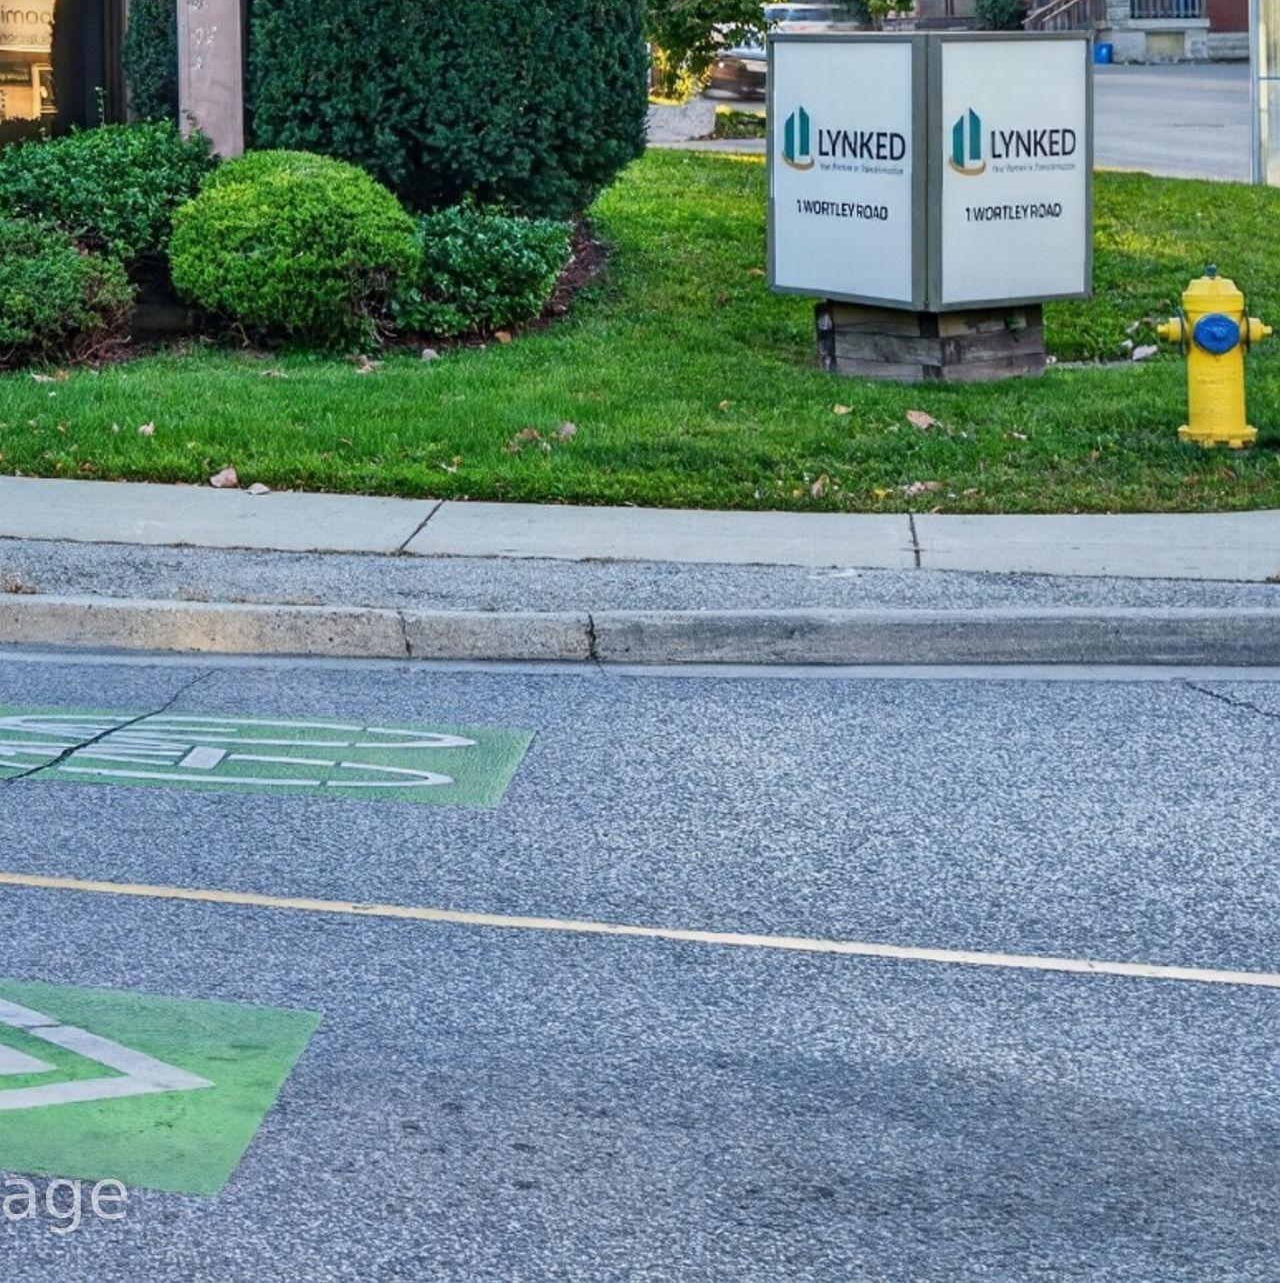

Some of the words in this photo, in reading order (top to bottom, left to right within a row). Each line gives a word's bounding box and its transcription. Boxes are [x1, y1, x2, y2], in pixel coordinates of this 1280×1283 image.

[818, 128, 906, 161] LYNKED
[991, 128, 1076, 158] LYNKED
[796, 199, 802, 213] 1
[803, 200, 855, 217] WORTLEY
[856, 205, 888, 220] ROAD
[965, 207, 971, 221] 1
[973, 204, 1029, 221] WORTLEY
[1030, 203, 1062, 218] ROAD
